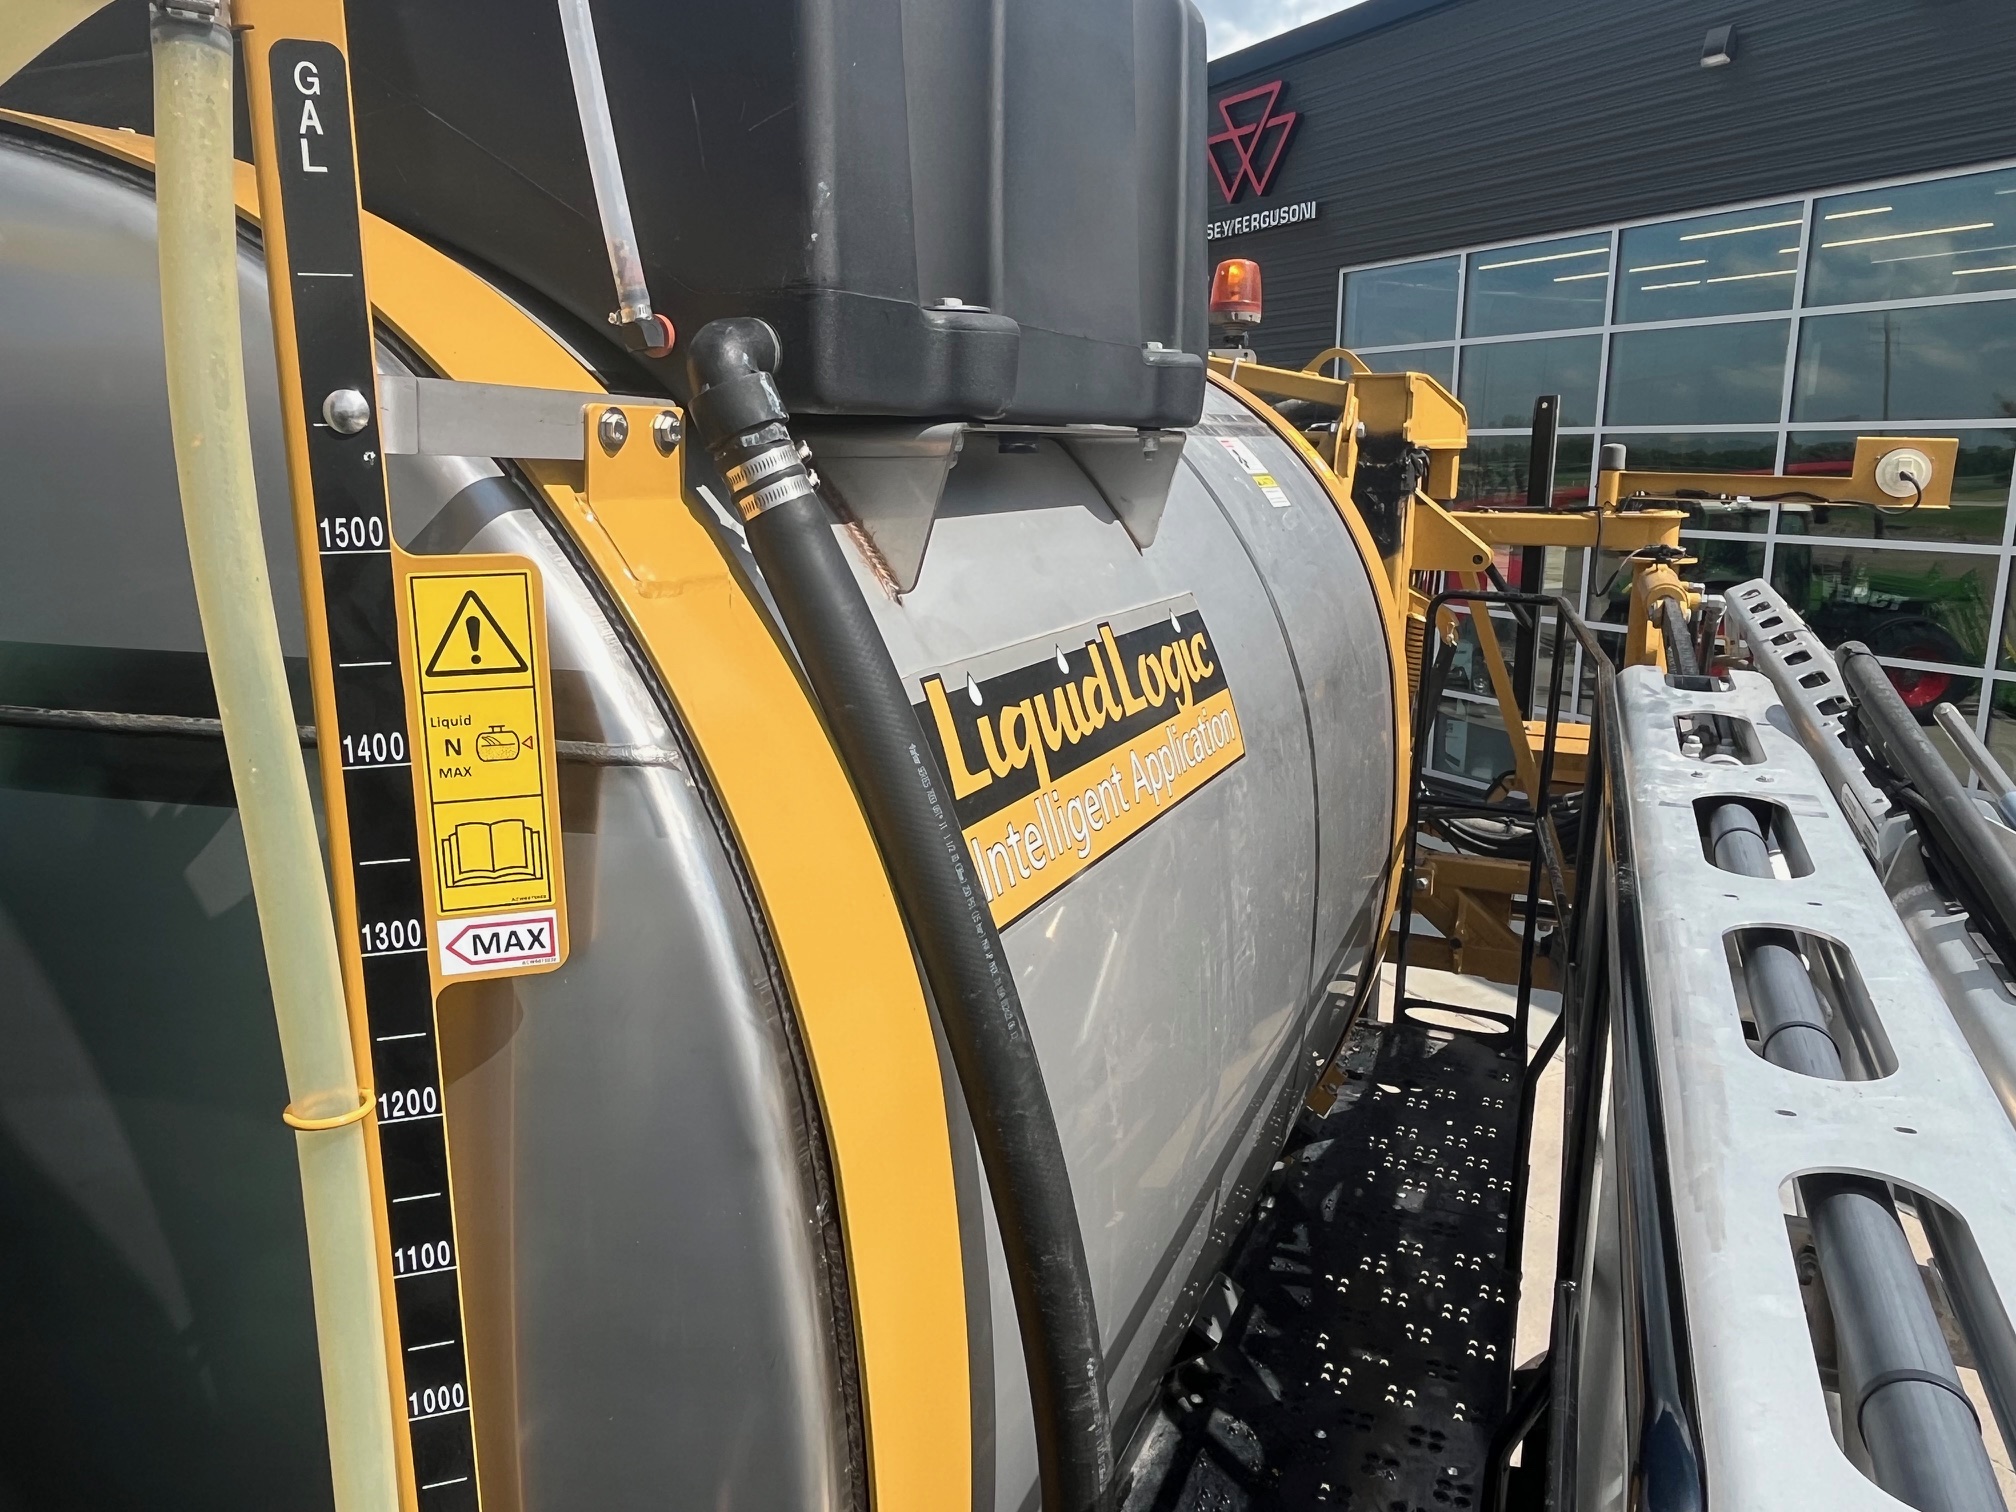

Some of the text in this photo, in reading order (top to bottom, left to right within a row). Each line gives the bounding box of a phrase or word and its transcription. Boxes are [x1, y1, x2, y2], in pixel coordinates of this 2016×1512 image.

[294, 61, 328, 172] GAL
[320, 516, 383, 547] 1500
[430, 715, 471, 729] Liquid
[924, 625, 1214, 800] LiquidLogic
[343, 732, 404, 763] 1400
[445, 738, 461, 756] N
[439, 766, 472, 778] MAX
[970, 707, 1236, 904] Intelligent Application
[362, 919, 421, 951] 1300
[472, 927, 546, 955] MAX
[379, 1086, 437, 1118] 1200
[394, 1240, 450, 1273] 1100
[409, 1383, 464, 1416] 1000
